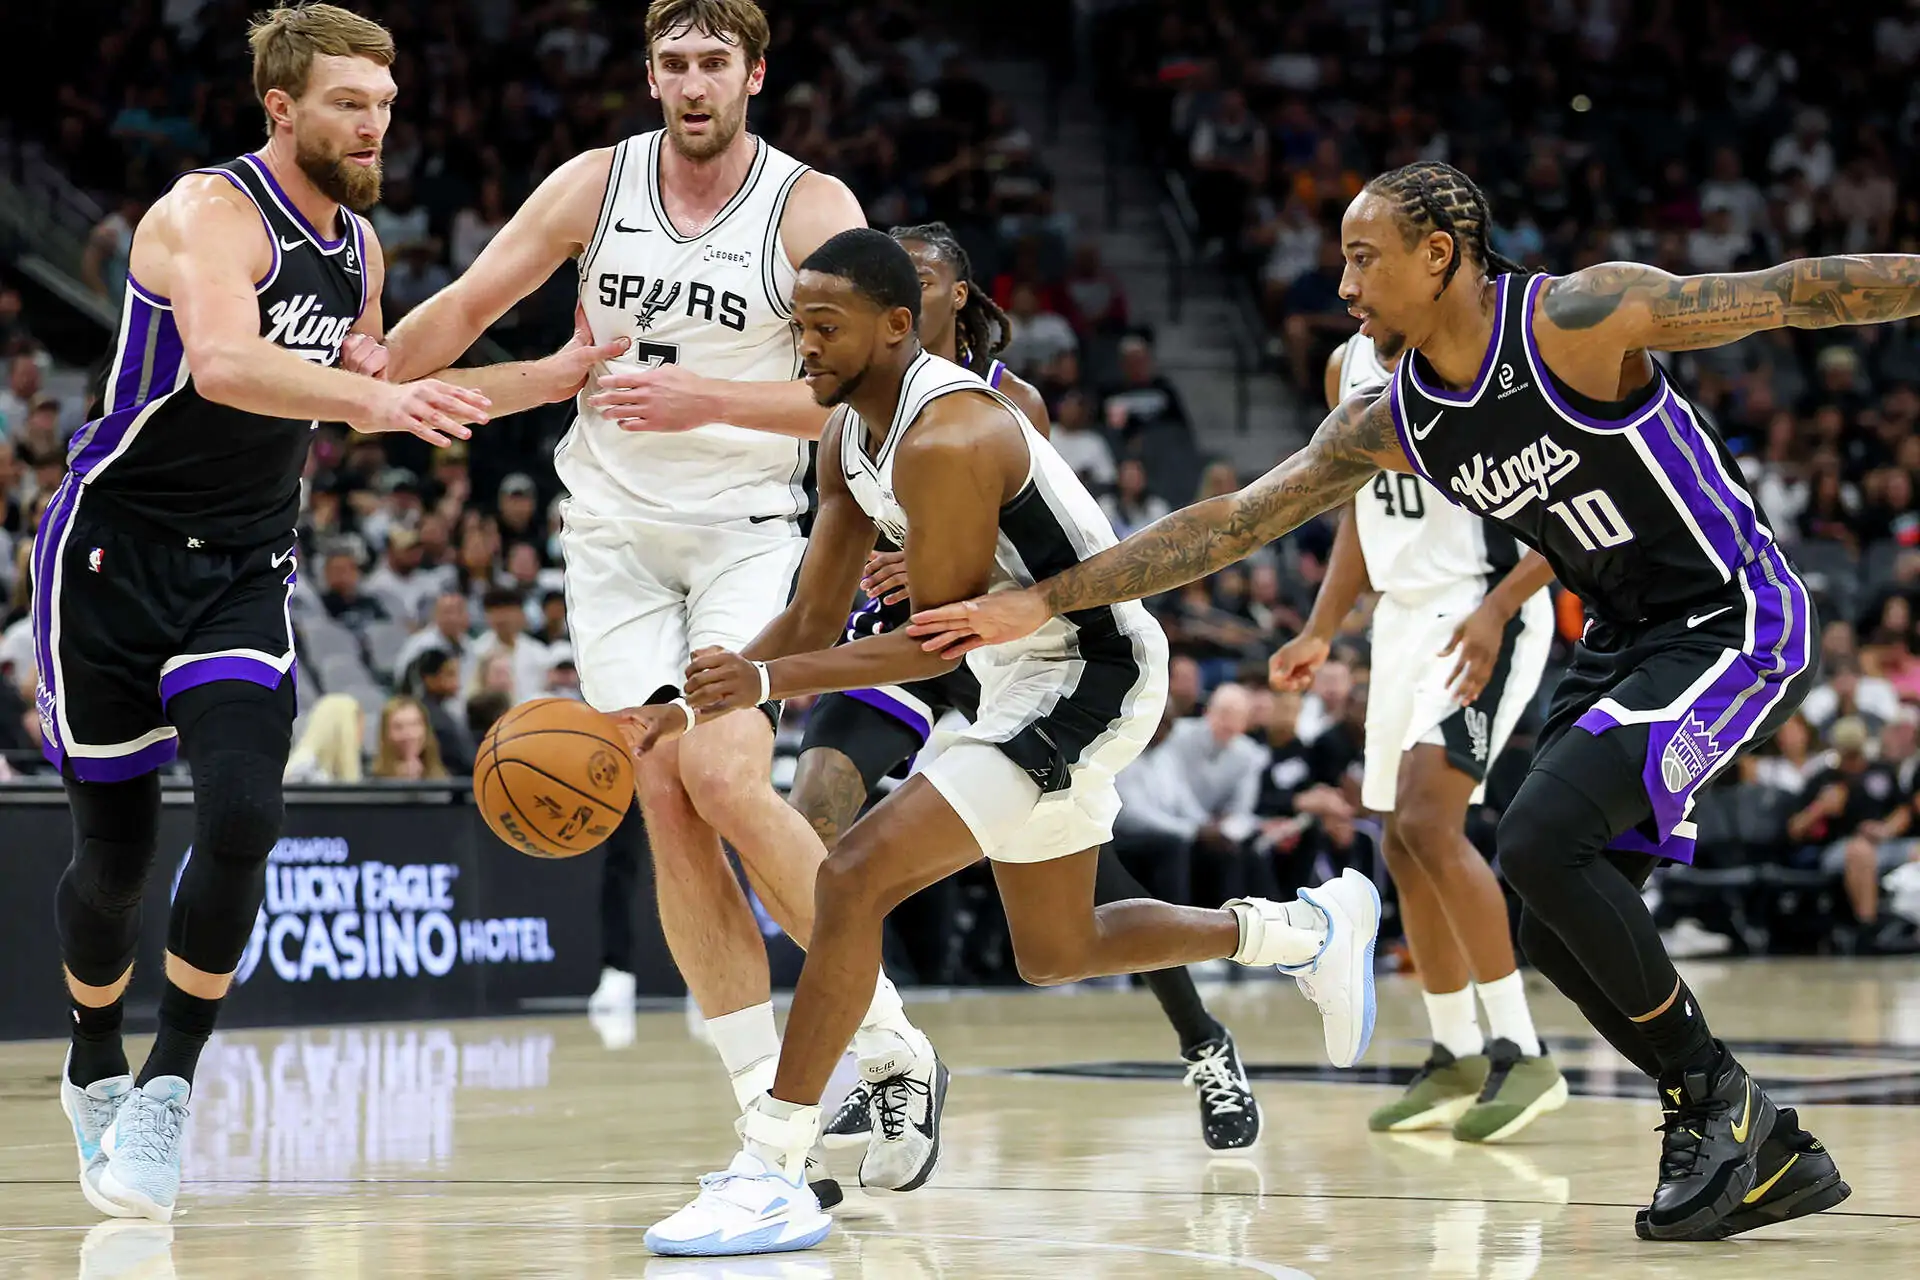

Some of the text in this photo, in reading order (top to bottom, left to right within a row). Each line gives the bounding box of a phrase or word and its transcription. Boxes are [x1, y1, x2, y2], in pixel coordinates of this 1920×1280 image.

[710, 249, 745, 264] LEDGER
[265, 294, 354, 366] King
[598, 273, 748, 332] SPURS
[1373, 470, 1425, 519] 40
[1450, 434, 1581, 520] Kings
[1547, 489, 1634, 551] 10
[1671, 735, 1702, 780] KINGS
[265, 861, 456, 914] LUCKY EAGLE
[268, 911, 555, 981] CASINO HOTEL
